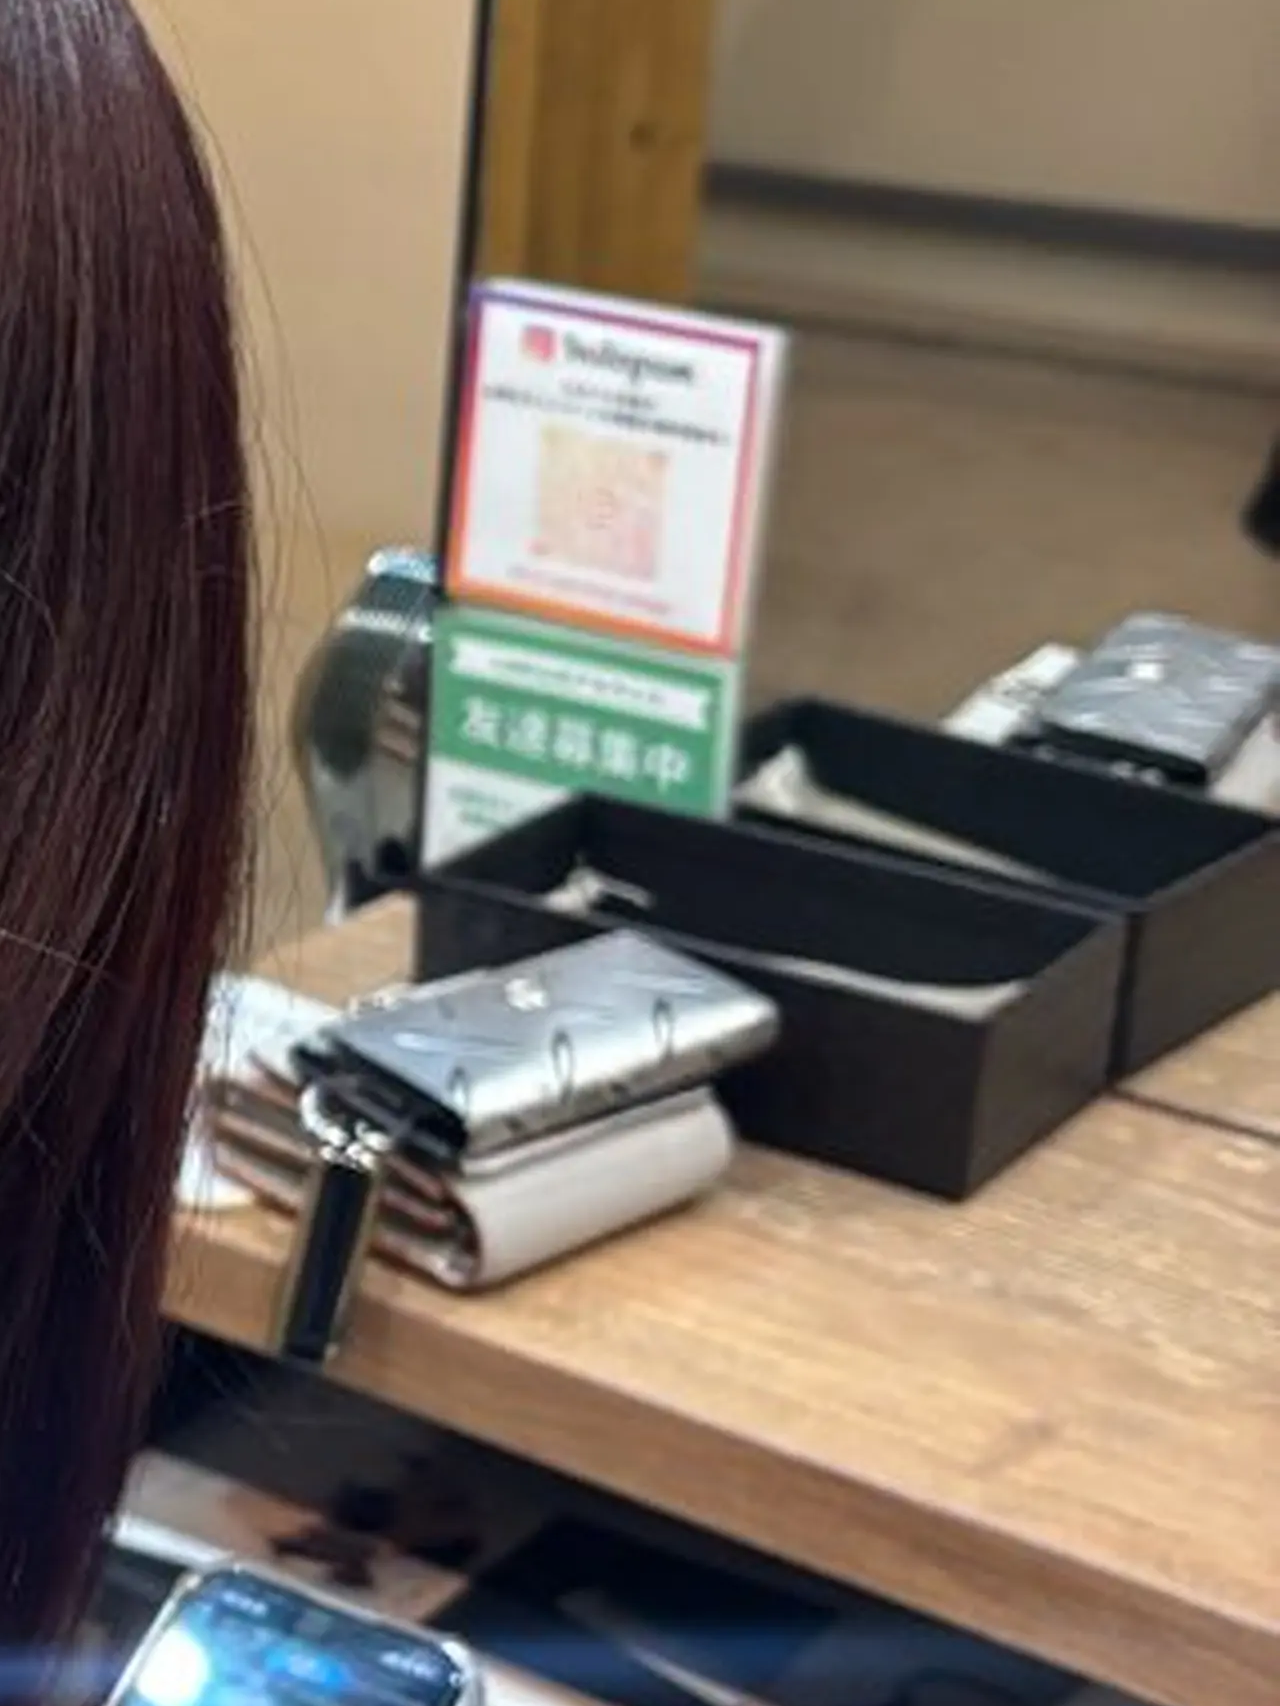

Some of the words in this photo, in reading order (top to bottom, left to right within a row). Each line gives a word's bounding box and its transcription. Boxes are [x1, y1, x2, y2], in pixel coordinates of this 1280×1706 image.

[461, 698, 690, 791] 友達募集中
